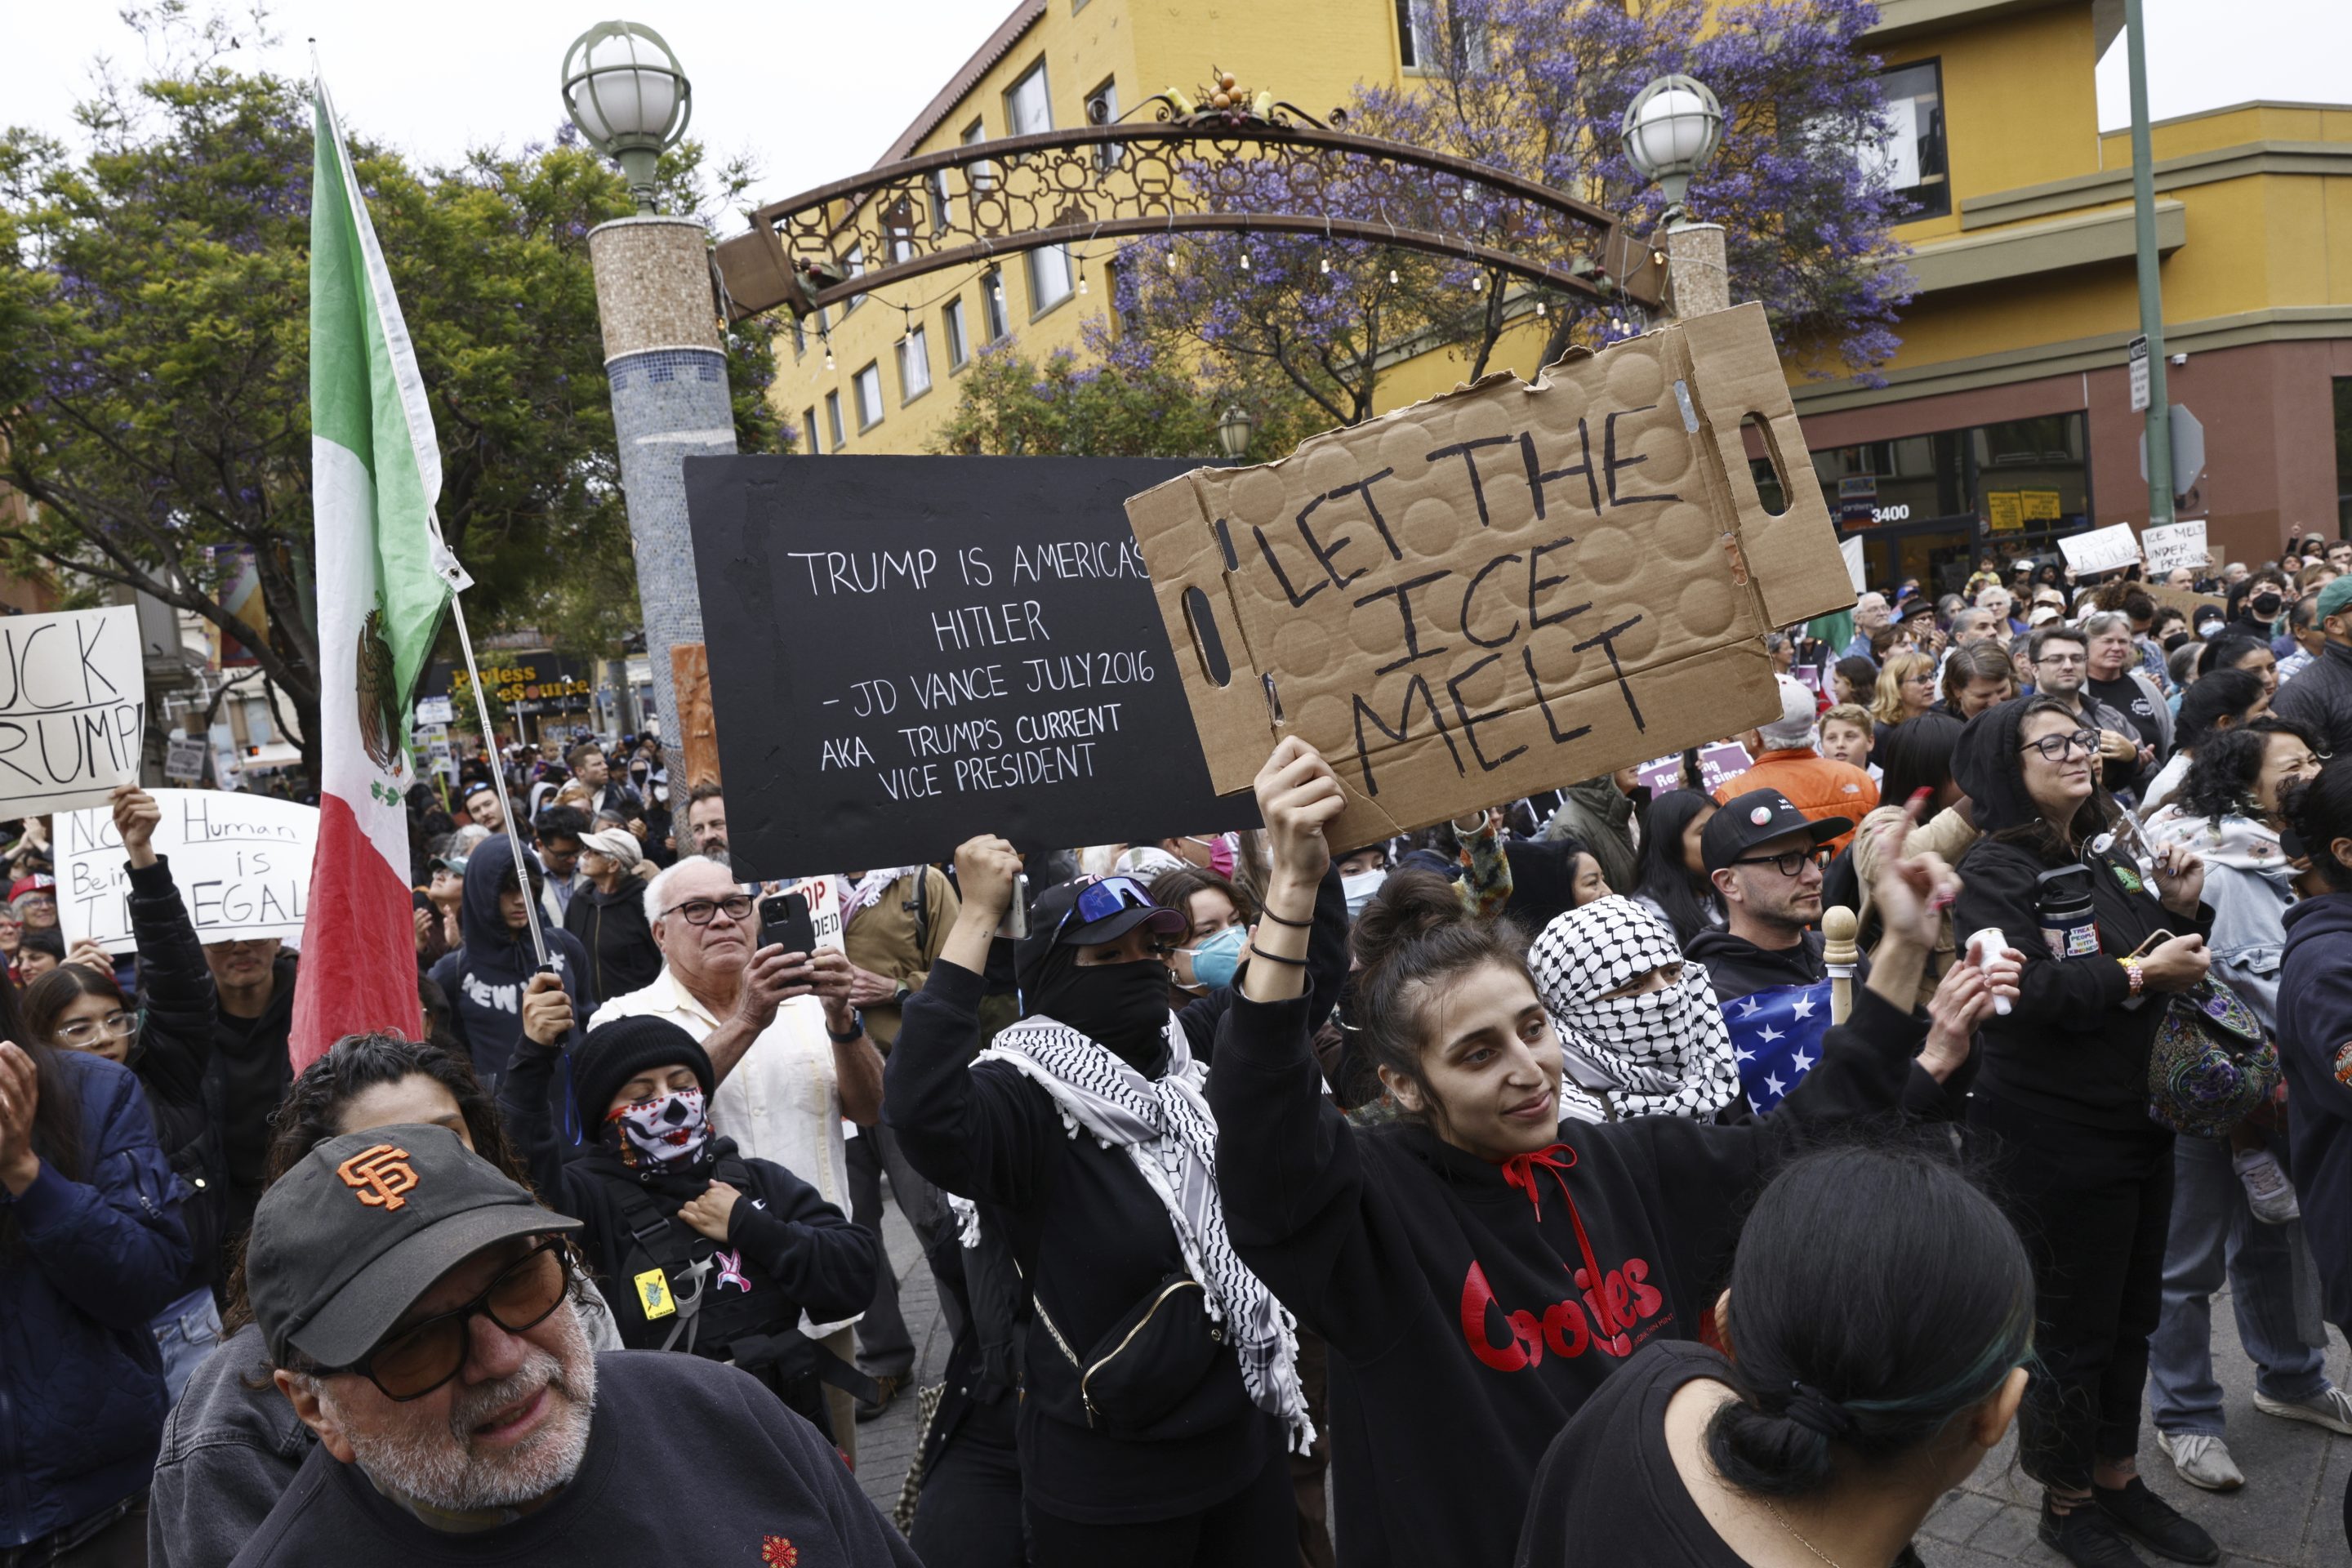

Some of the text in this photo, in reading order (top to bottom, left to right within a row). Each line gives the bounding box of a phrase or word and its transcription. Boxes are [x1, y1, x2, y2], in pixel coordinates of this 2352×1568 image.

[1253, 405, 1684, 608] LET THE
[1871, 505, 1909, 523] 3400
[2146, 530, 2167, 544] ICE
[2148, 543, 2188, 559] UNDER
[788, 536, 1150, 595] TRUMP IS AMERICA'S
[932, 600, 1050, 651] HITLER
[1353, 537, 1592, 676] ICE
[452, 666, 537, 689] Pyless
[850, 679, 897, 717] JD
[910, 665, 1009, 710] VANCE
[1023, 653, 1091, 693] JULY
[1098, 650, 1155, 684] 2016
[1352, 614, 1646, 796] MELT
[822, 703, 1122, 771] AKA TRUMP'S CURRENT
[878, 742, 1097, 800] VICE PRESIDENT
[184, 797, 296, 841] Human
[237, 851, 271, 876] is
[2070, 931, 2095, 942] PEOPLE
[461, 972, 518, 1014] NEW
